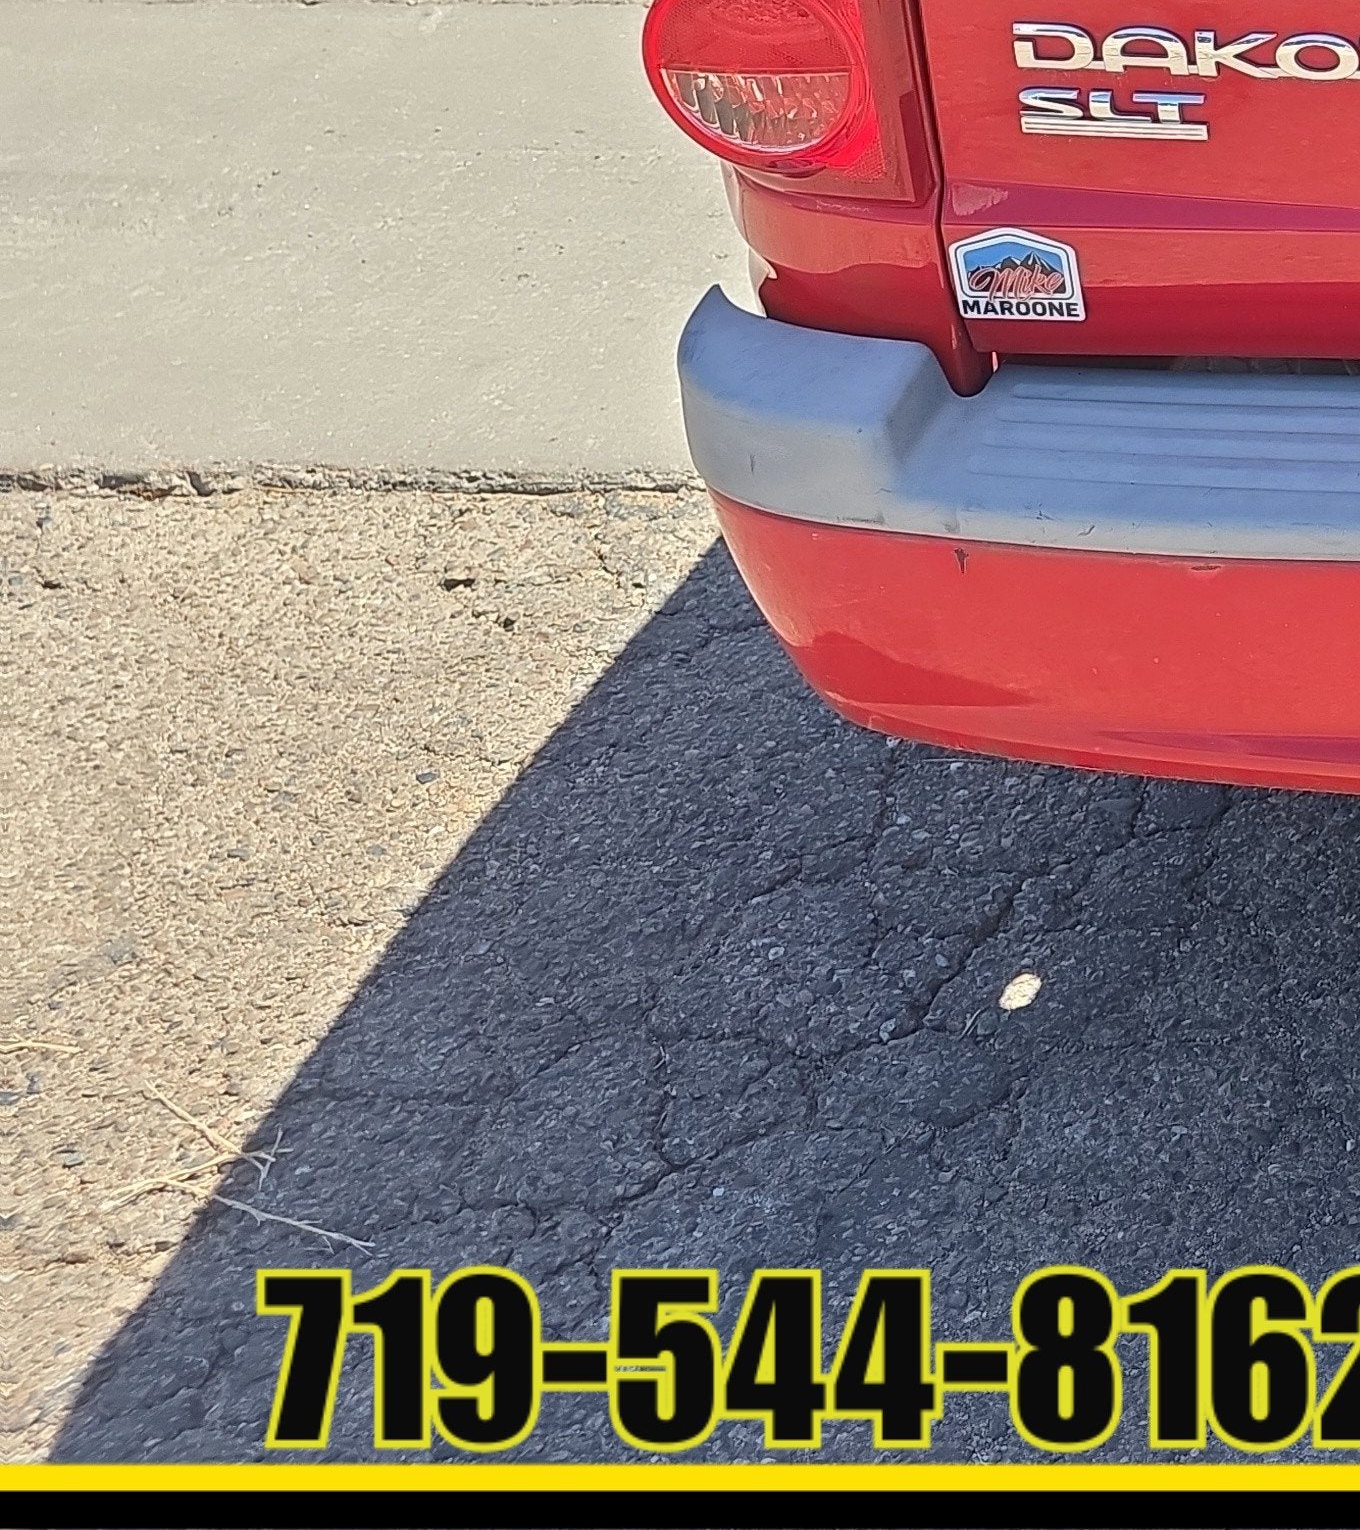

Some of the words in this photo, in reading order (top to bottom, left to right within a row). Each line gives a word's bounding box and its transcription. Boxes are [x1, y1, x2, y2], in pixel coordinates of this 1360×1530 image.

[1018, 86, 1206, 126] SLT
[968, 264, 1064, 302] Mike
[962, 299, 1080, 317] MAROONE
